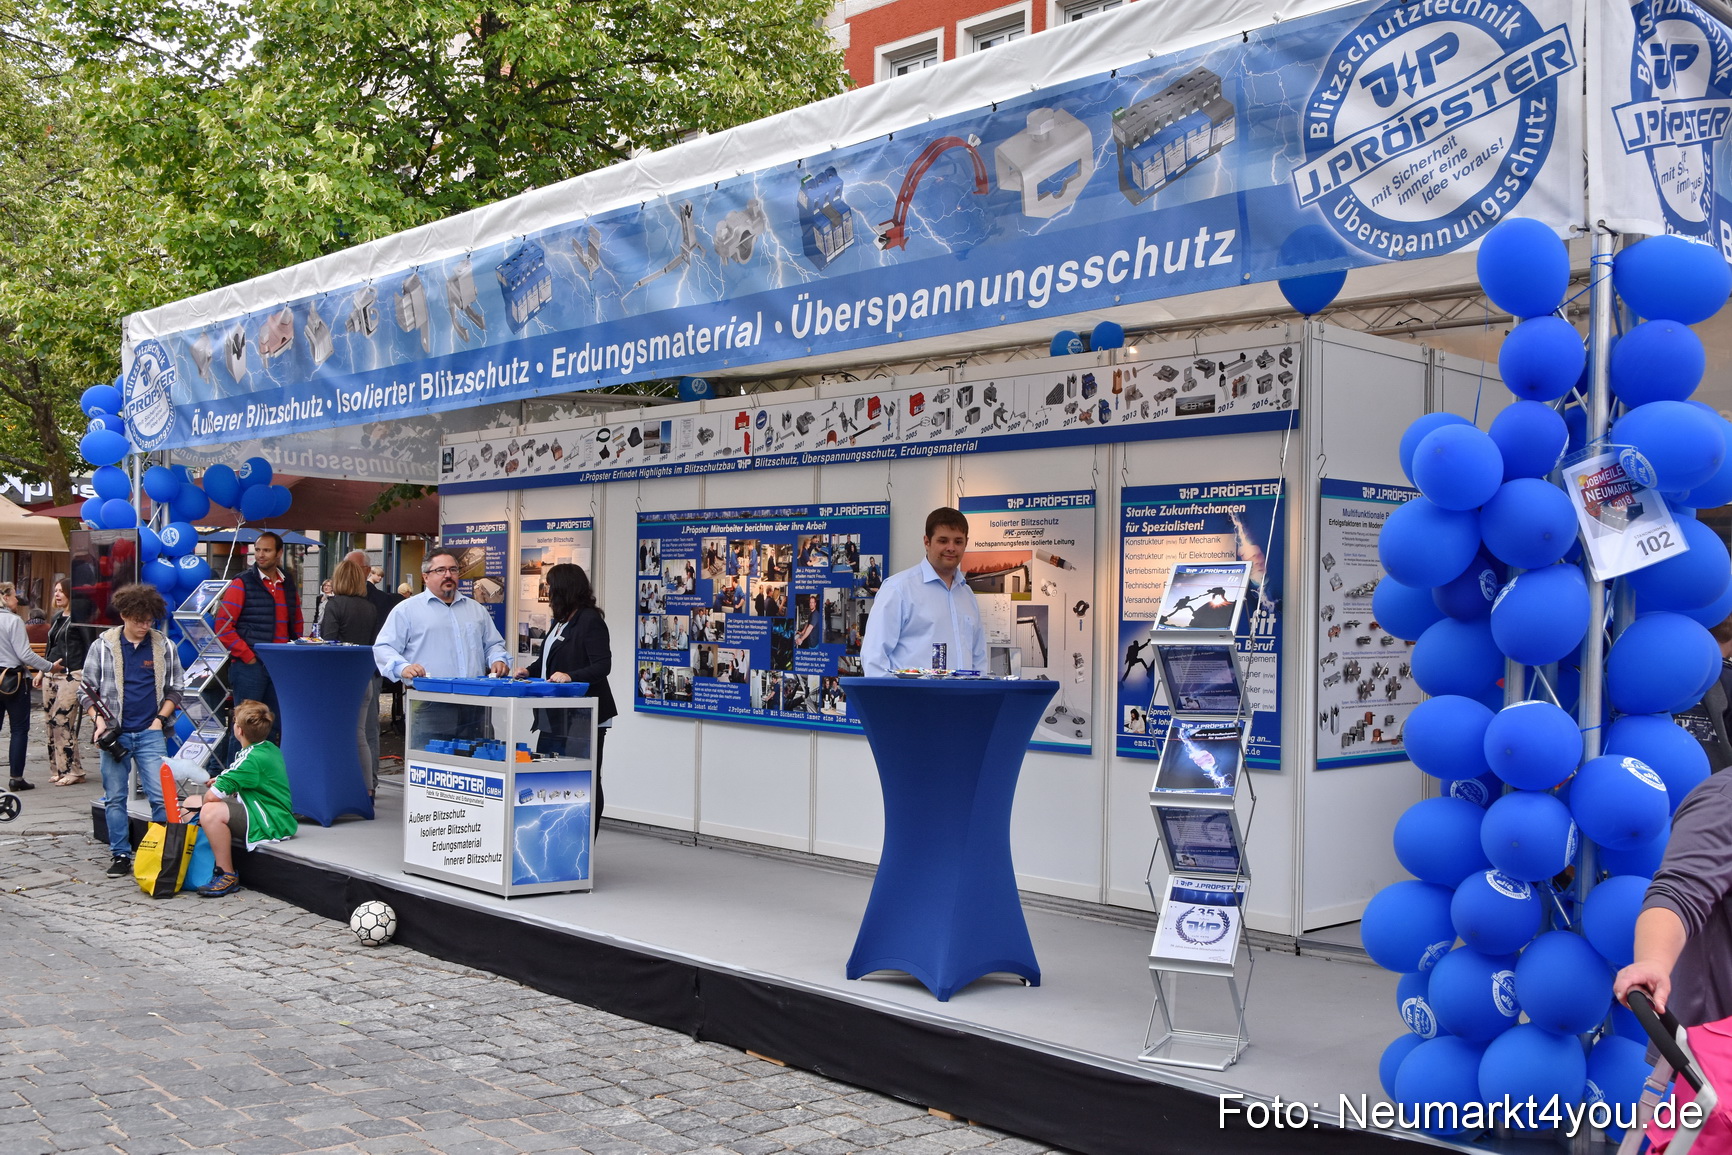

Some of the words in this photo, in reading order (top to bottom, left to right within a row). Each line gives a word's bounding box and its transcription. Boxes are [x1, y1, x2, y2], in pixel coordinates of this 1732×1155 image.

[1309, 0, 1522, 139] Blitzschutztechnik
[1301, 38, 1572, 202] J.PRÖPSTER
[1334, 97, 1547, 257] Überspannungsschutz
[1371, 184, 1392, 208] mit
[1391, 135, 1459, 190] Sicherheit
[1396, 165, 1435, 207] immer
[1438, 147, 1469, 174] eine
[1421, 179, 1451, 206] Idee
[1453, 137, 1505, 181] voraus!
[190, 407, 244, 436] Äußerer
[246, 393, 324, 428] Blitzschutz
[335, 382, 416, 414] Isolierter
[420, 360, 530, 401] Blitzschutz
[551, 311, 762, 378] Erdungsmaterial
[790, 227, 1237, 338] Überspannungsschutz
[881, 432, 894, 443] 2004
[905, 429, 918, 441] 2005
[929, 427, 943, 439] 2006
[954, 425, 968, 437] 2007
[980, 422, 994, 435] 2008
[1007, 419, 1021, 432] 2009
[1034, 417, 1049, 430] 2010
[1062, 415, 1078, 428] 2012
[1121, 409, 1138, 422] 2013
[1152, 407, 1169, 420] 2014
[1217, 401, 1235, 414] 2015
[1251, 398, 1269, 411] 2016
[579, 470, 612, 483] J.Pröpster
[612, 469, 638, 480] Erfindet
[638, 466, 673, 479] Highlights
[673, 465, 683, 475] im
[684, 461, 736, 474] Blitzschutzbau
[754, 455, 799, 468] Blitzschutz,
[801, 446, 898, 465] Überspannungsschutz,
[900, 440, 979, 457] Erdungsmaterial
[1585, 465, 1624, 489] JOBMEILE
[1200, 482, 1280, 498] J.PRÖPSTER
[1585, 481, 1632, 503] NEUMARKT
[1025, 494, 1091, 508] J.PRÖPSTER
[833, 503, 887, 517] J.PRÖPSTER
[1125, 505, 1157, 518] Starke
[1159, 502, 1246, 517] Zukunftschancen
[710, 523, 744, 534] Mitarbeiter
[744, 522, 774, 533] berichten
[774, 520, 791, 532] über
[791, 520, 805, 531] ihre
[805, 519, 827, 531] Arbeit
[989, 519, 1020, 528] Isolierter
[1020, 517, 1059, 527] Blitzschutz
[1125, 521, 1140, 533] für
[1141, 519, 1205, 535] Spezialisten!
[974, 540, 1030, 548] Hochspannungsfeste
[1053, 537, 1075, 546] Leitung
[1125, 537, 1165, 546] Konstrukteur
[1178, 536, 1188, 545] für
[1189, 535, 1222, 545] Mechanik
[1636, 530, 1675, 557] 102
[1124, 552, 1164, 561] Konstrukteur
[1178, 551, 1188, 560] für
[1189, 550, 1236, 560] Elektrotechnik
[1124, 581, 1162, 590] Technischer
[427, 771, 484, 793] J.PRÖPSTER
[408, 811, 431, 824] Äußerer
[432, 808, 466, 822] Blitzschutz
[420, 825, 446, 838] Isolierter
[447, 822, 481, 836] Blitzschutz
[432, 838, 482, 853] Erdungsmaterial
[443, 853, 466, 867] Innerer
[466, 853, 502, 865] Blitzschutz
